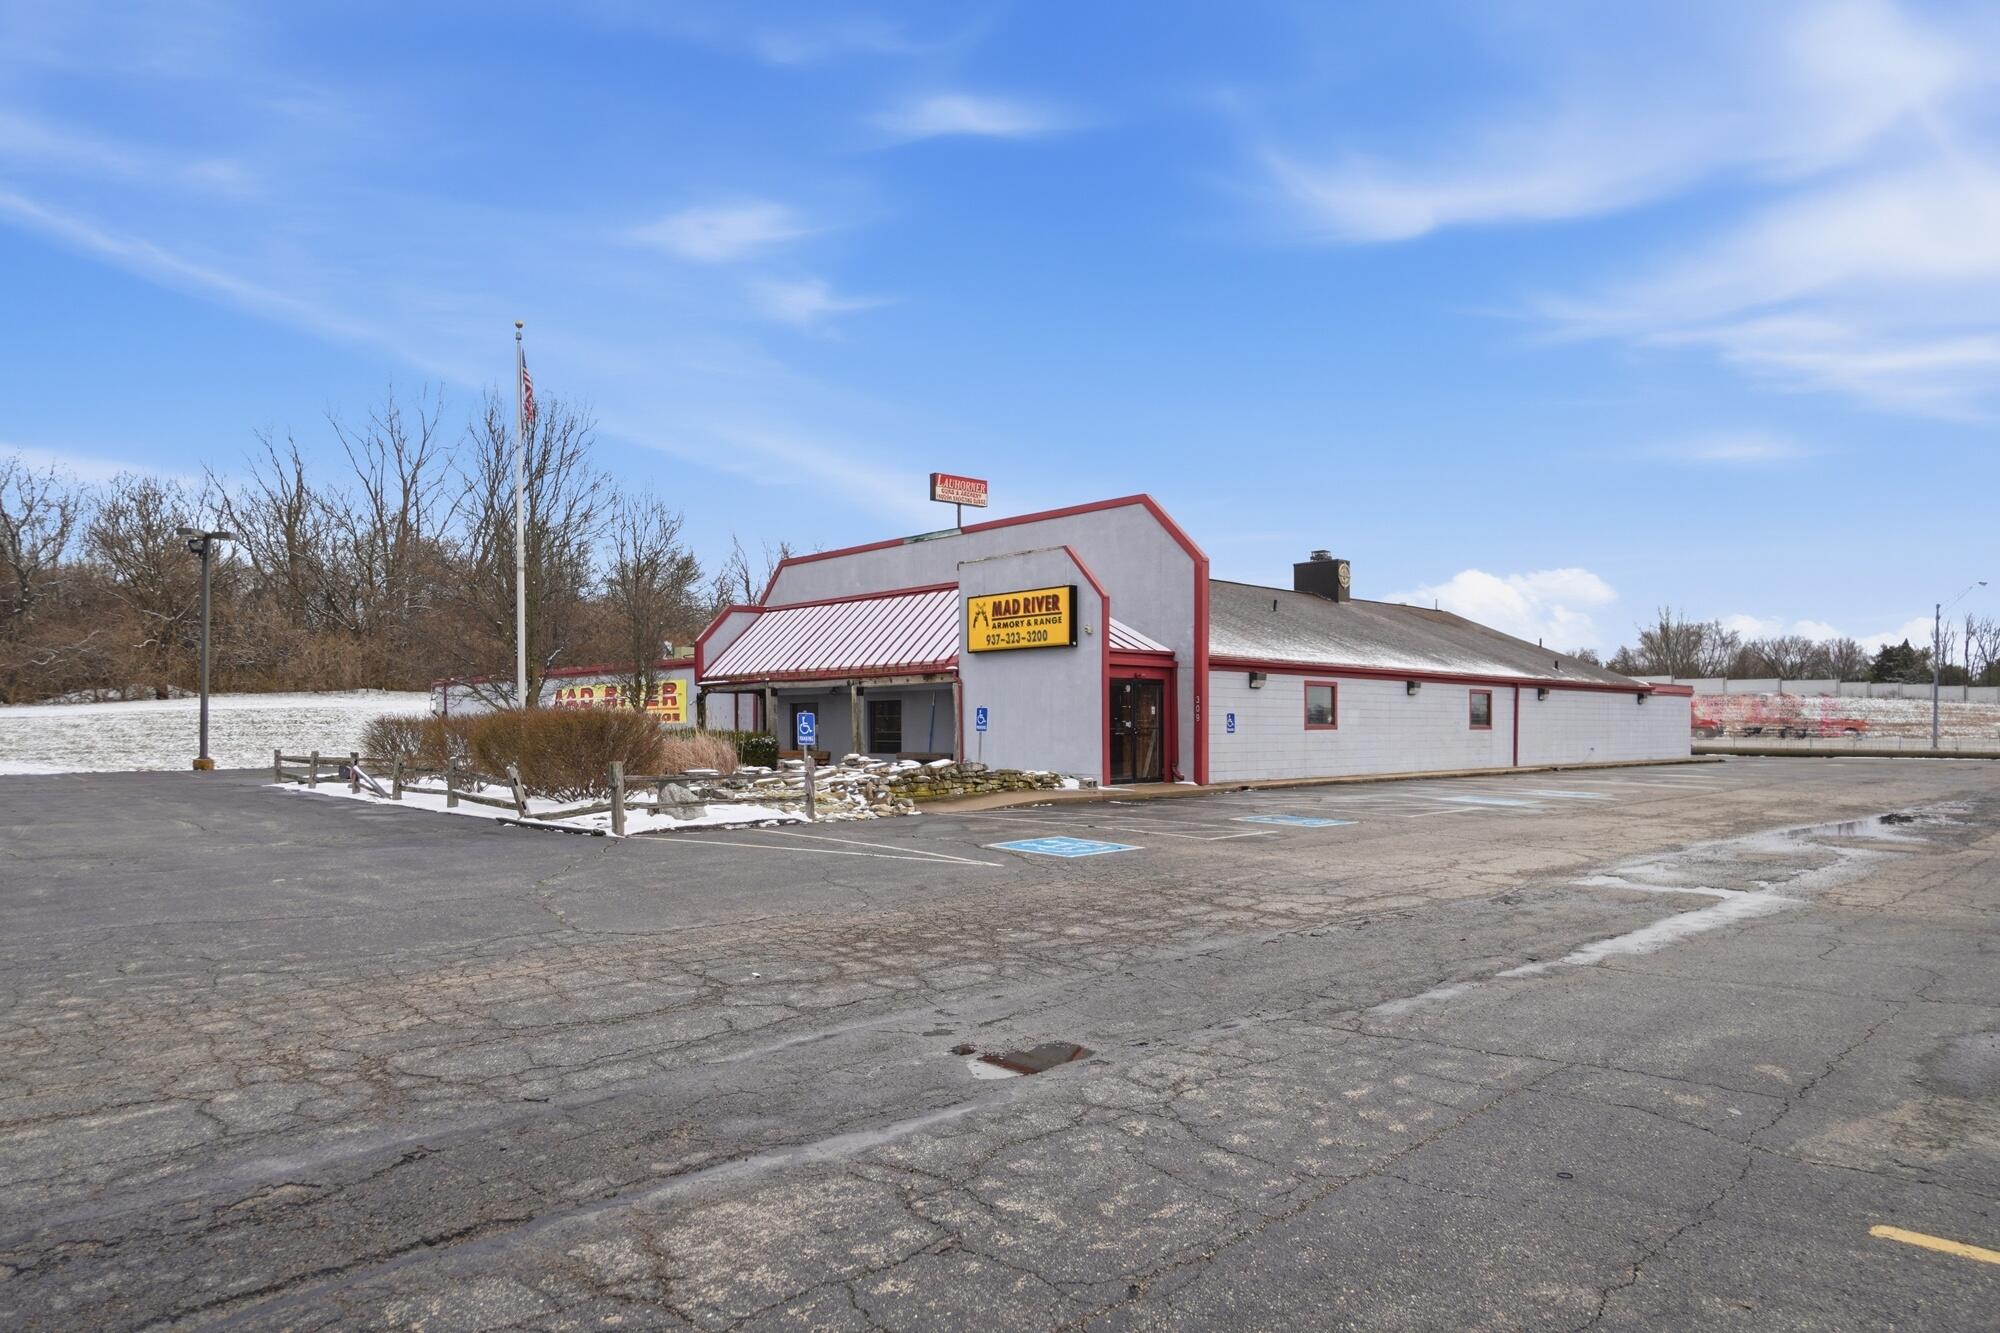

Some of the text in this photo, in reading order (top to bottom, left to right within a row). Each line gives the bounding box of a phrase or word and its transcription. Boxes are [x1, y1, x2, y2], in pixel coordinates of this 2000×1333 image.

[991, 594, 1060, 617] MAD RIVER
[991, 620, 1025, 630] ARMORY
[1034, 616, 1062, 626] RANGE
[986, 629, 1048, 646] 937-323-3200
